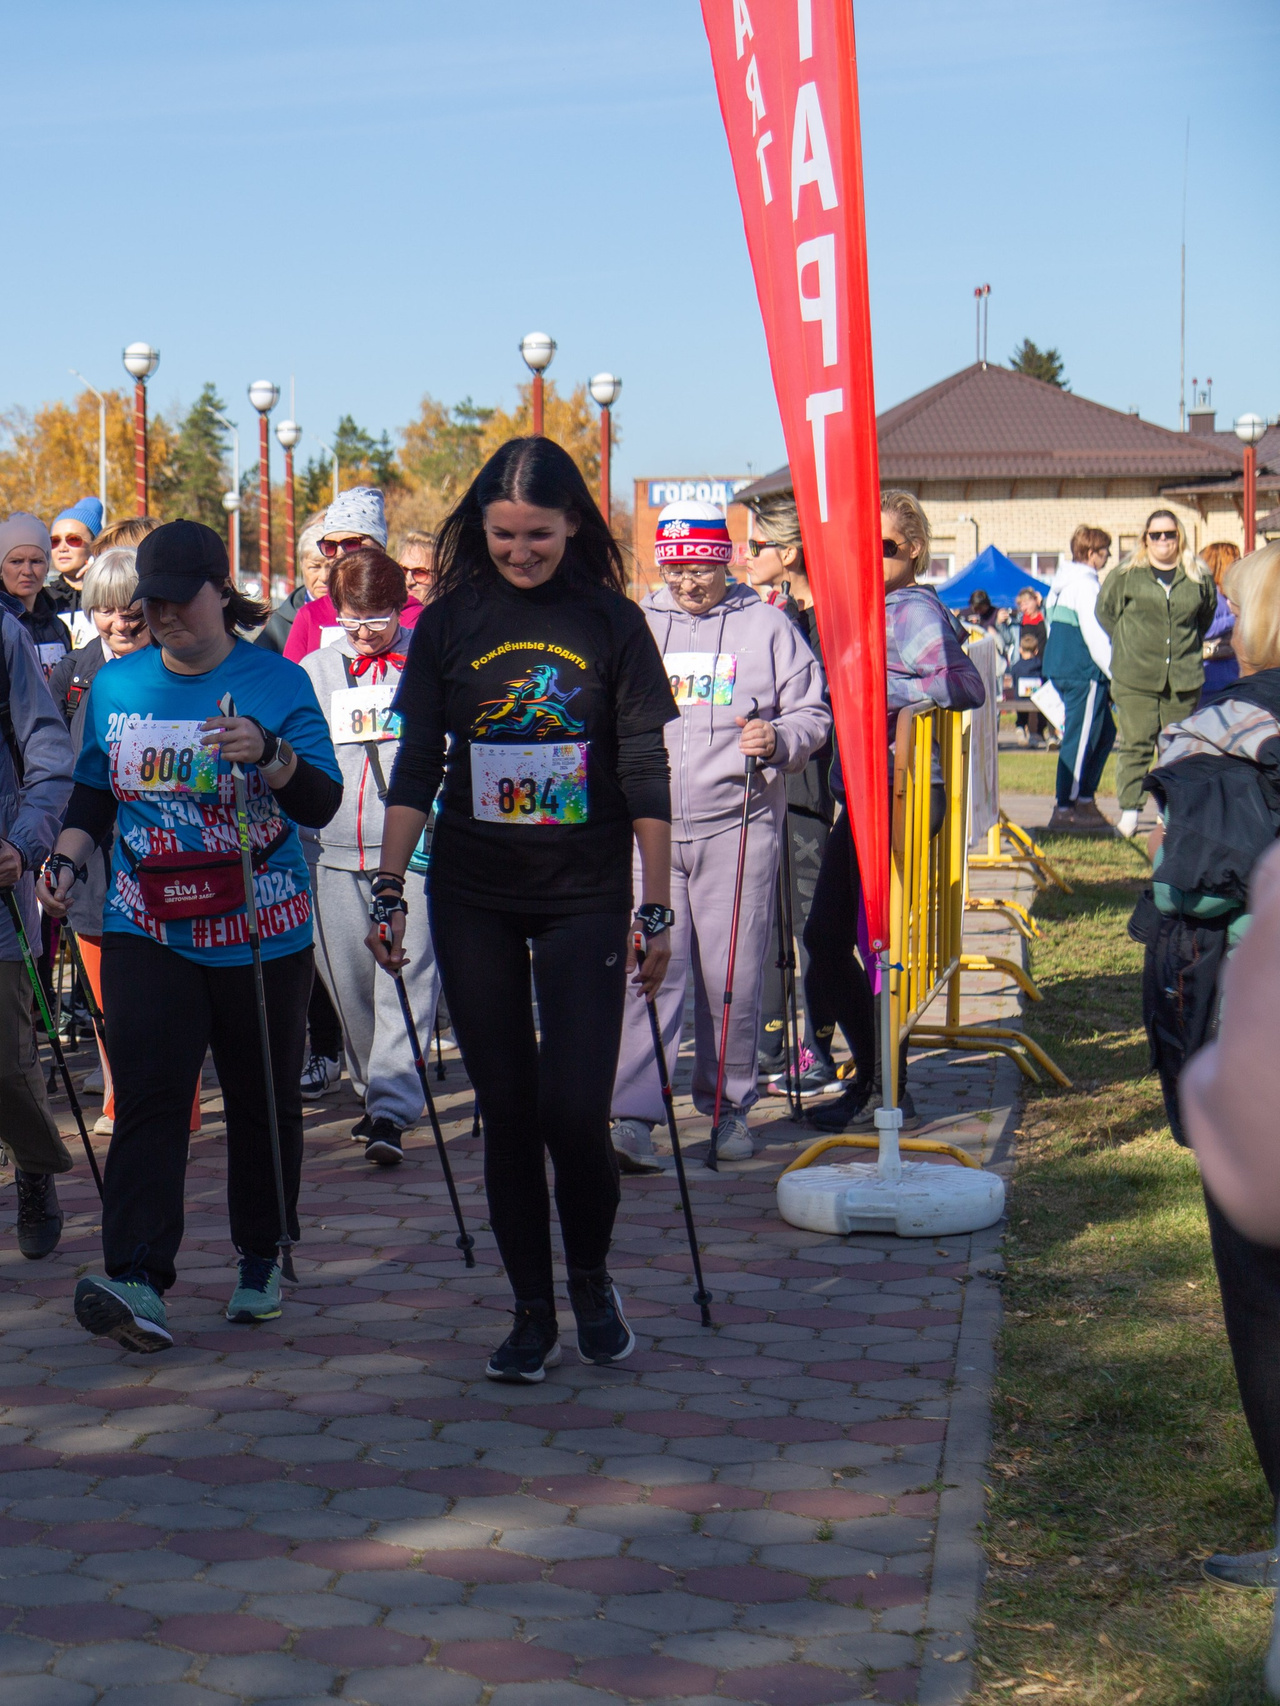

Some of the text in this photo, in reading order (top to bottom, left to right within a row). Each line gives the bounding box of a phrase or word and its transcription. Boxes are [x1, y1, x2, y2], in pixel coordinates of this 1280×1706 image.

[652, 483, 726, 506] ГОРОД
[471, 641, 587, 670] Рождённые ходить
[351, 706, 394, 734] 812
[140, 747, 194, 782] 808
[498, 777, 559, 815] 834
[237, 811, 249, 851] LEKI
